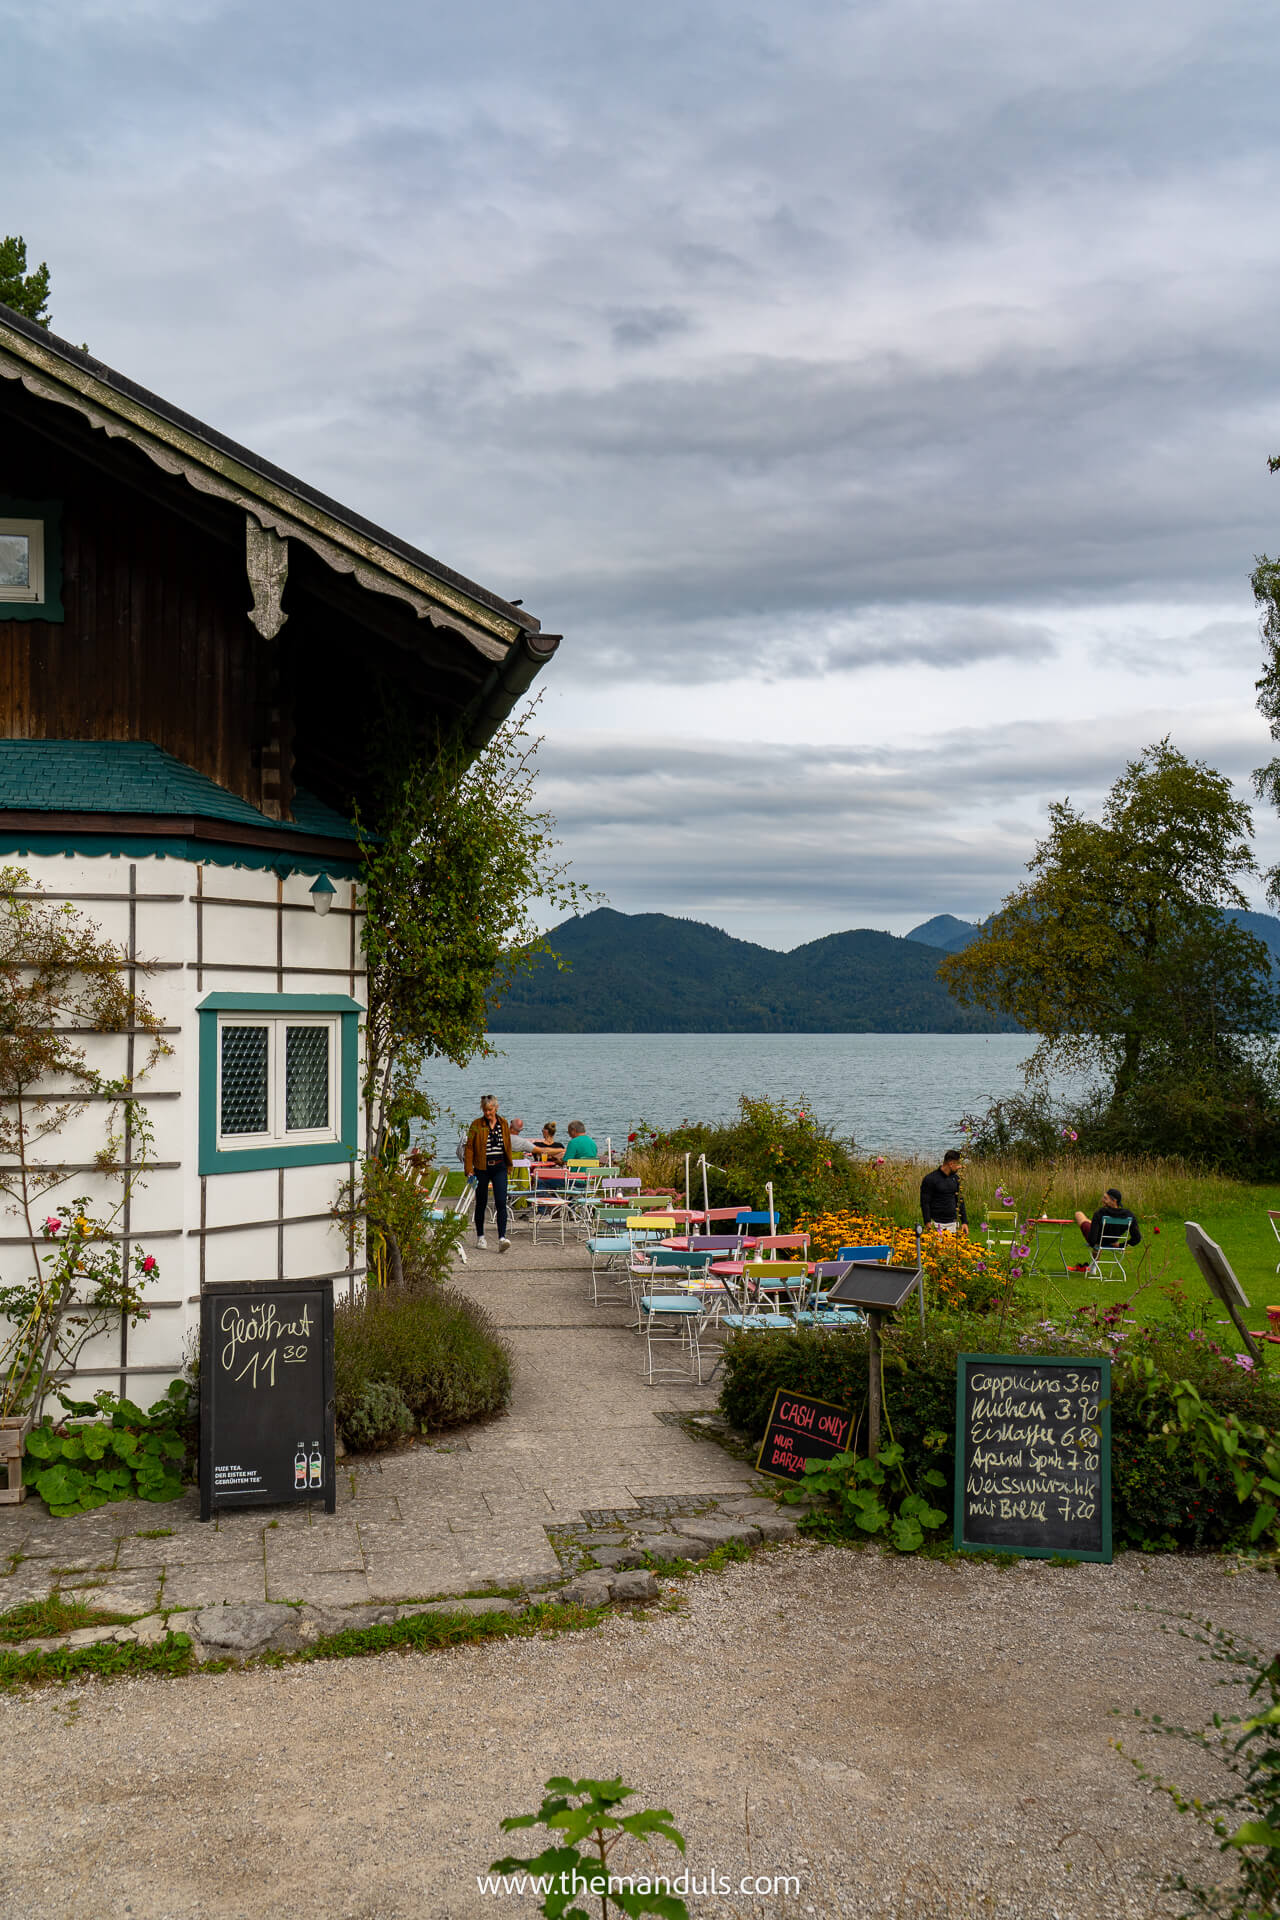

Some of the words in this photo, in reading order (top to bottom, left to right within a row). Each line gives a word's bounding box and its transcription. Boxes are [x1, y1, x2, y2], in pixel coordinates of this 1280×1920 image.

[971, 1396, 1046, 1421] Kuchen
[1054, 1396, 1099, 1423] 3.90
[780, 1401, 816, 1430] CASH
[818, 1415, 848, 1445] ONLY
[773, 1433, 793, 1451] NUR
[1060, 1426, 1098, 1448] 6.80
[969, 1497, 997, 1518] mit
